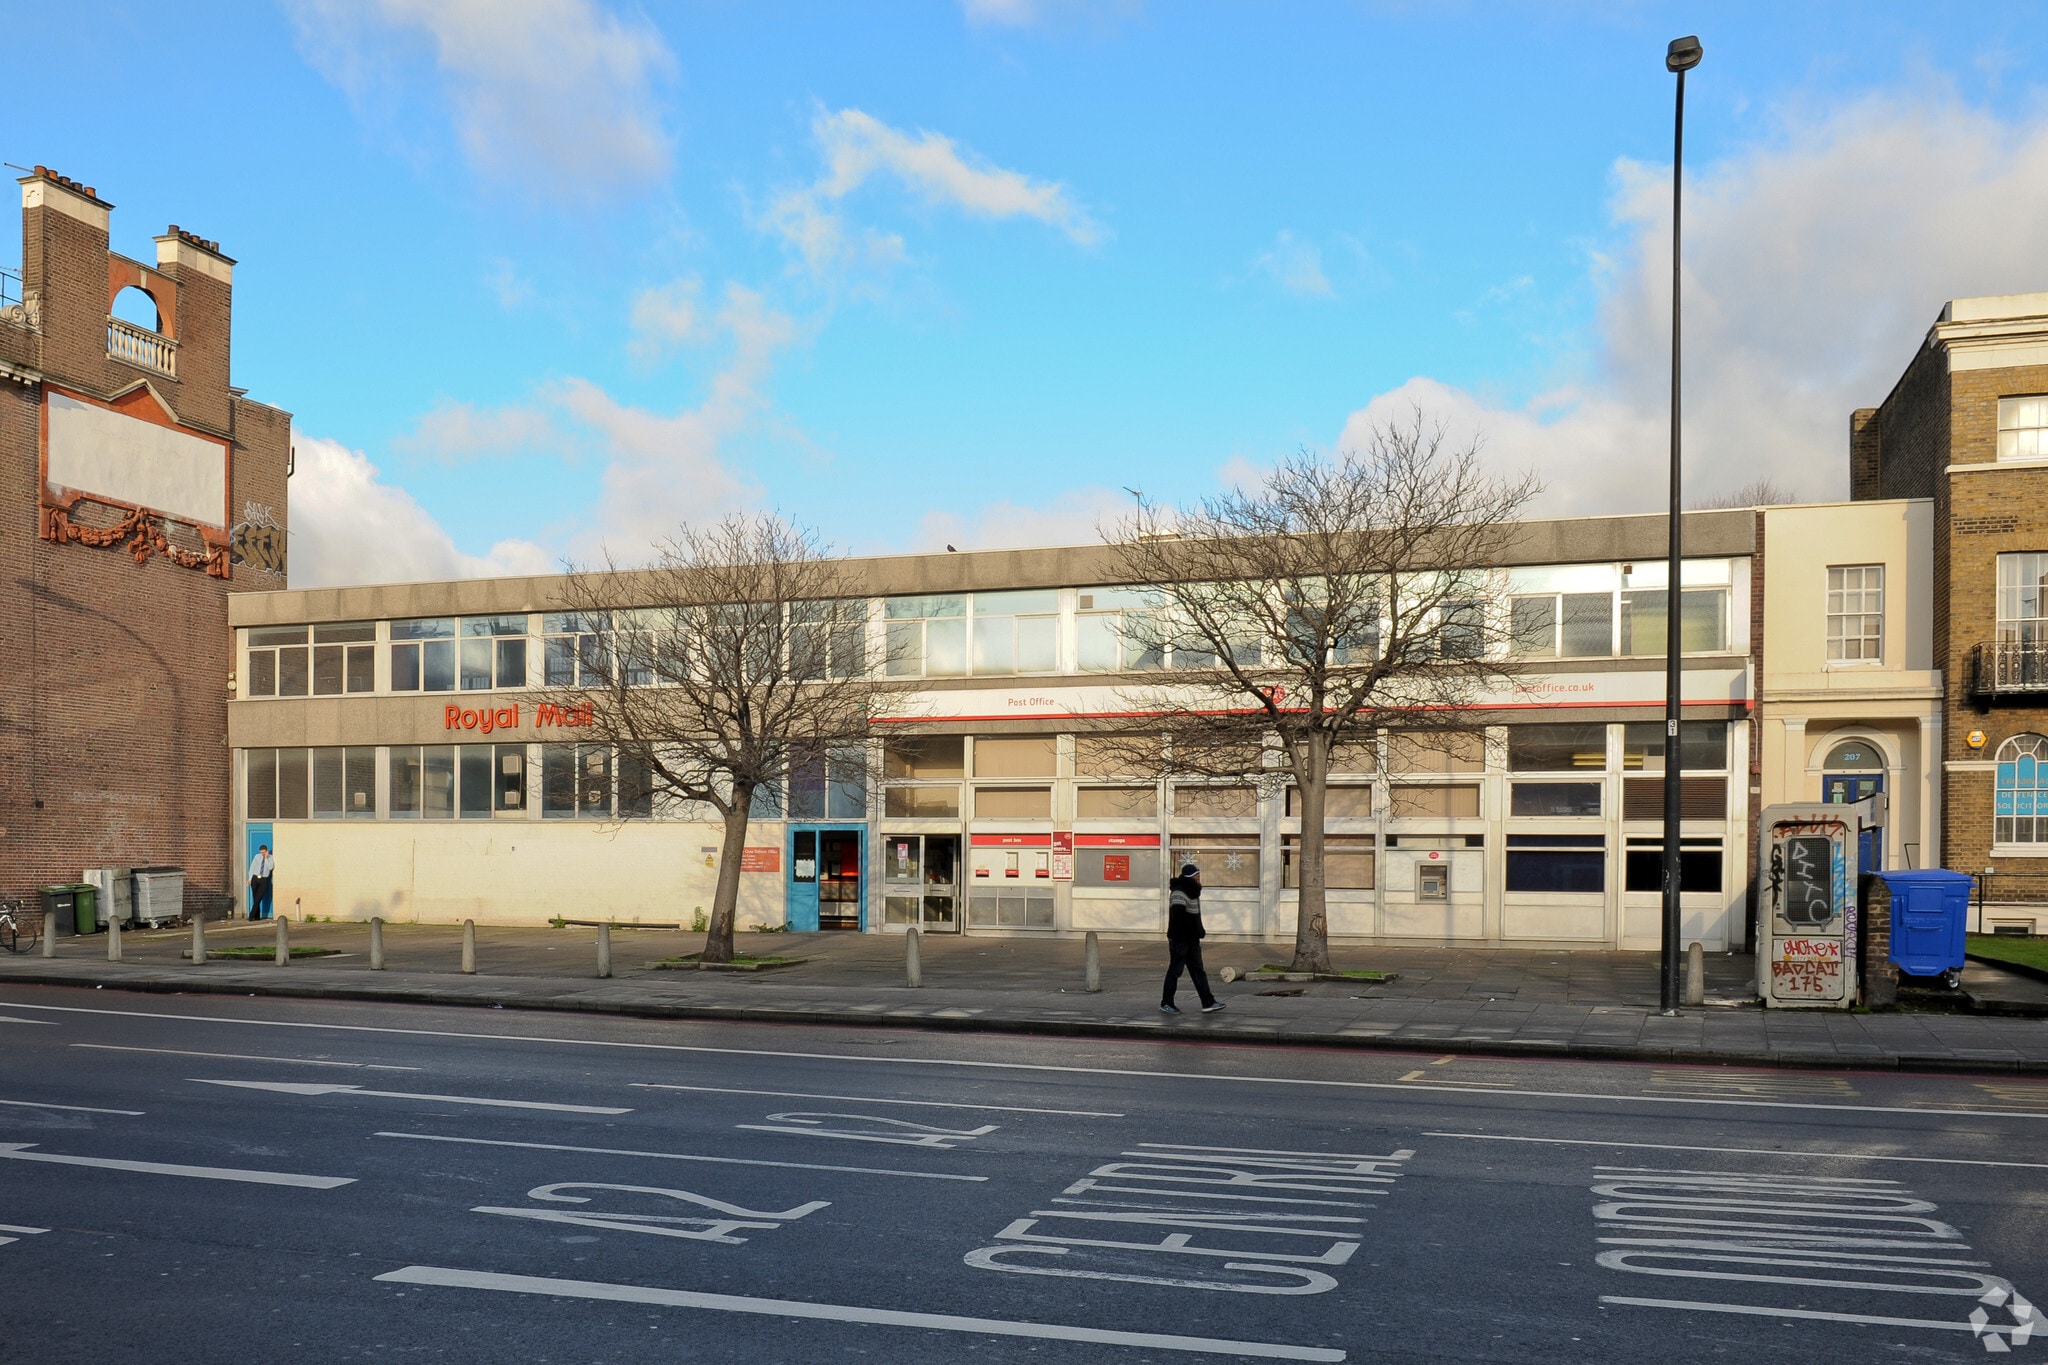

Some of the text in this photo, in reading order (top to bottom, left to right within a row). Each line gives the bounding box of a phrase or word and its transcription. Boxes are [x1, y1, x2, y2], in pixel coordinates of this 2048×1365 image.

[444, 702, 593, 733] Royal Mail
[1008, 697, 1054, 706] Post Office
[1844, 753, 1861, 761] 207
[1789, 976, 1823, 992] 175
[736, 1111, 1001, 1148] A2
[469, 1182, 833, 1245] A2
[963, 1142, 1416, 1295] CENTRAL
[1590, 1165, 2048, 1336] LONDON
